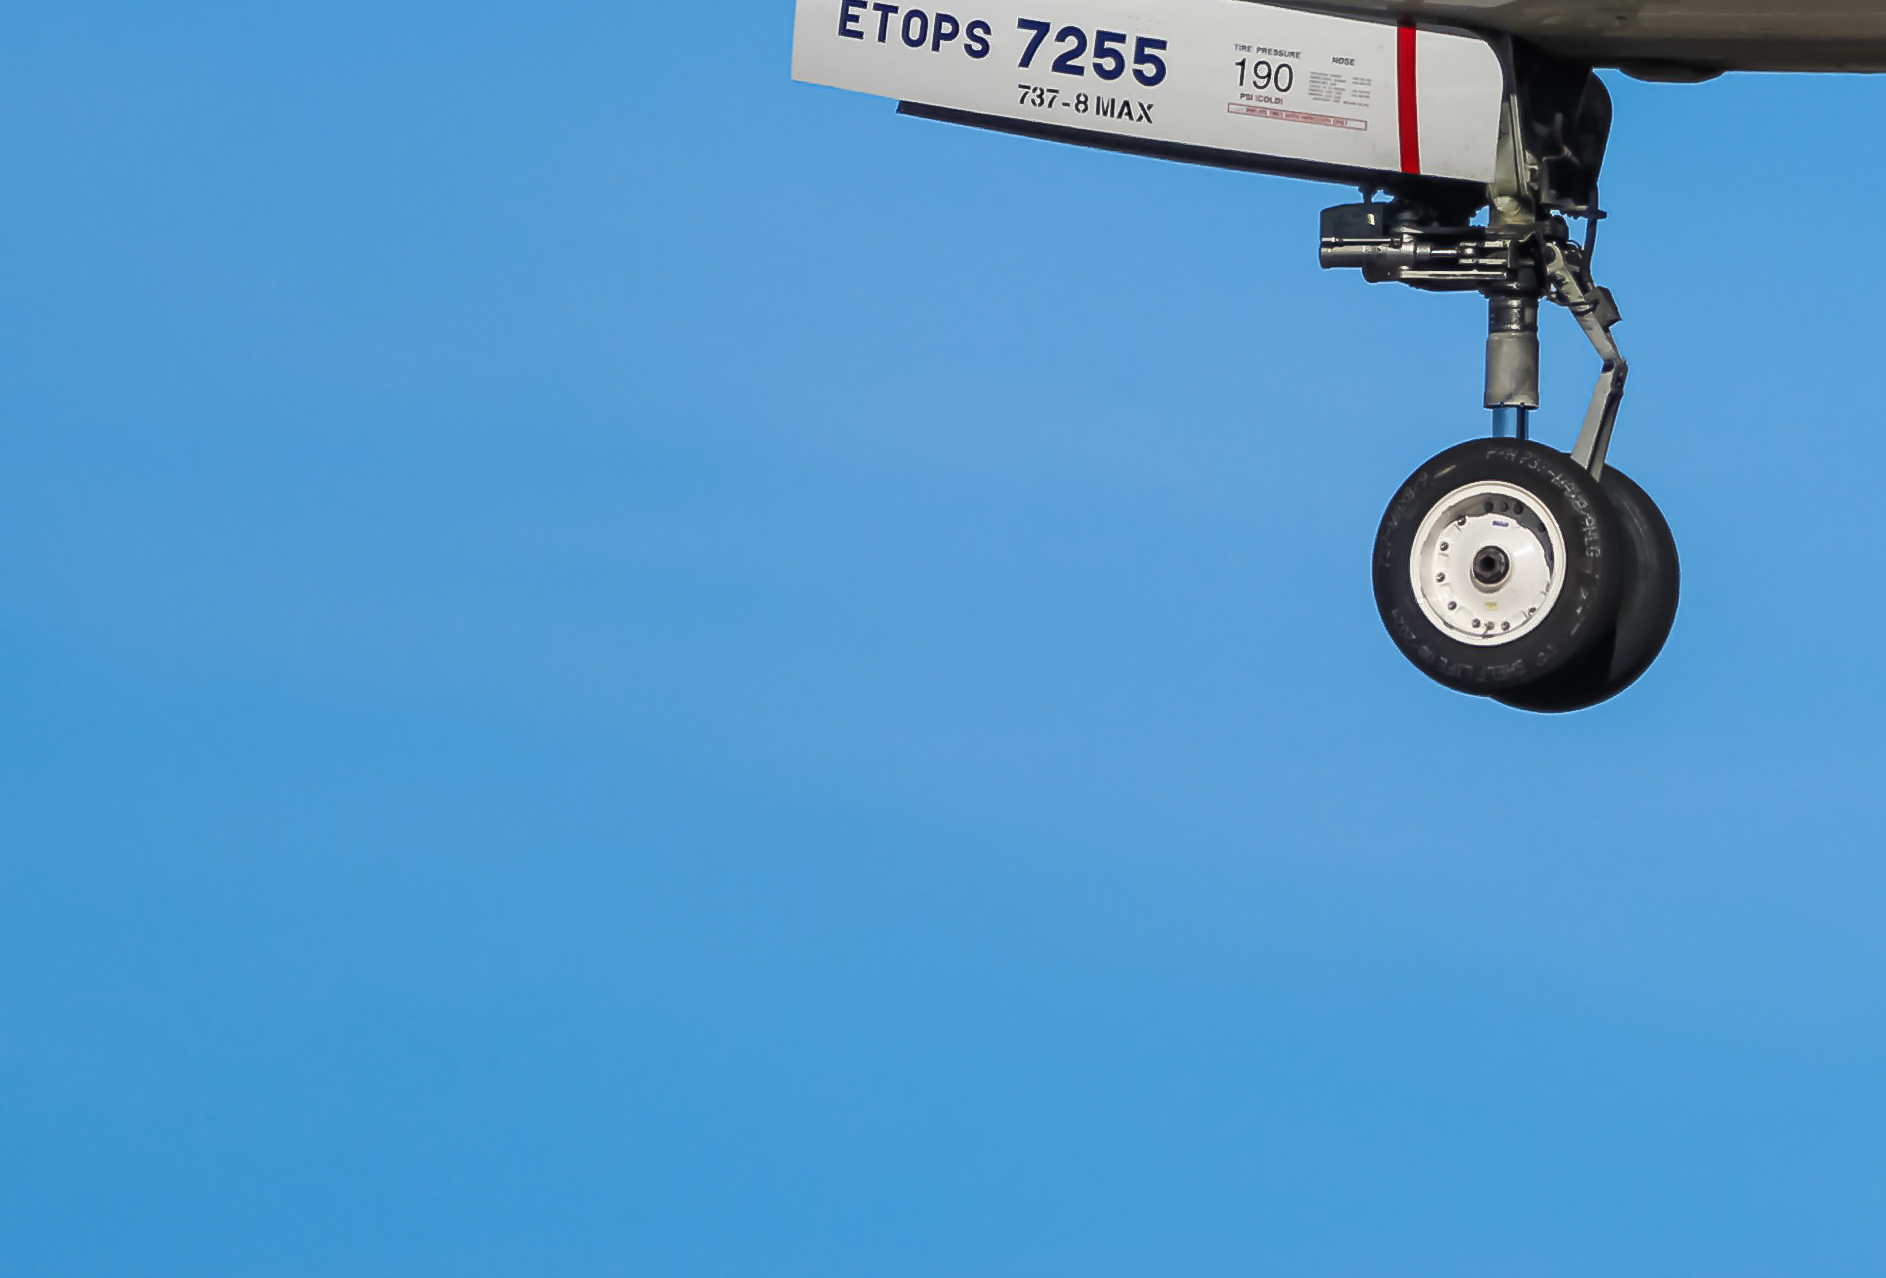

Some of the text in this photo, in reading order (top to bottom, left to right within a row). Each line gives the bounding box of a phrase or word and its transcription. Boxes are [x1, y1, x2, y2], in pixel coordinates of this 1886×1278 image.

[1015, 17, 1168, 88] 7255
[1234, 44, 1302, 59] TIRE PRESSURE
[1331, 56, 1356, 66] NOSE
[1235, 58, 1294, 93] 190
[1095, 94, 1154, 124] MAX
